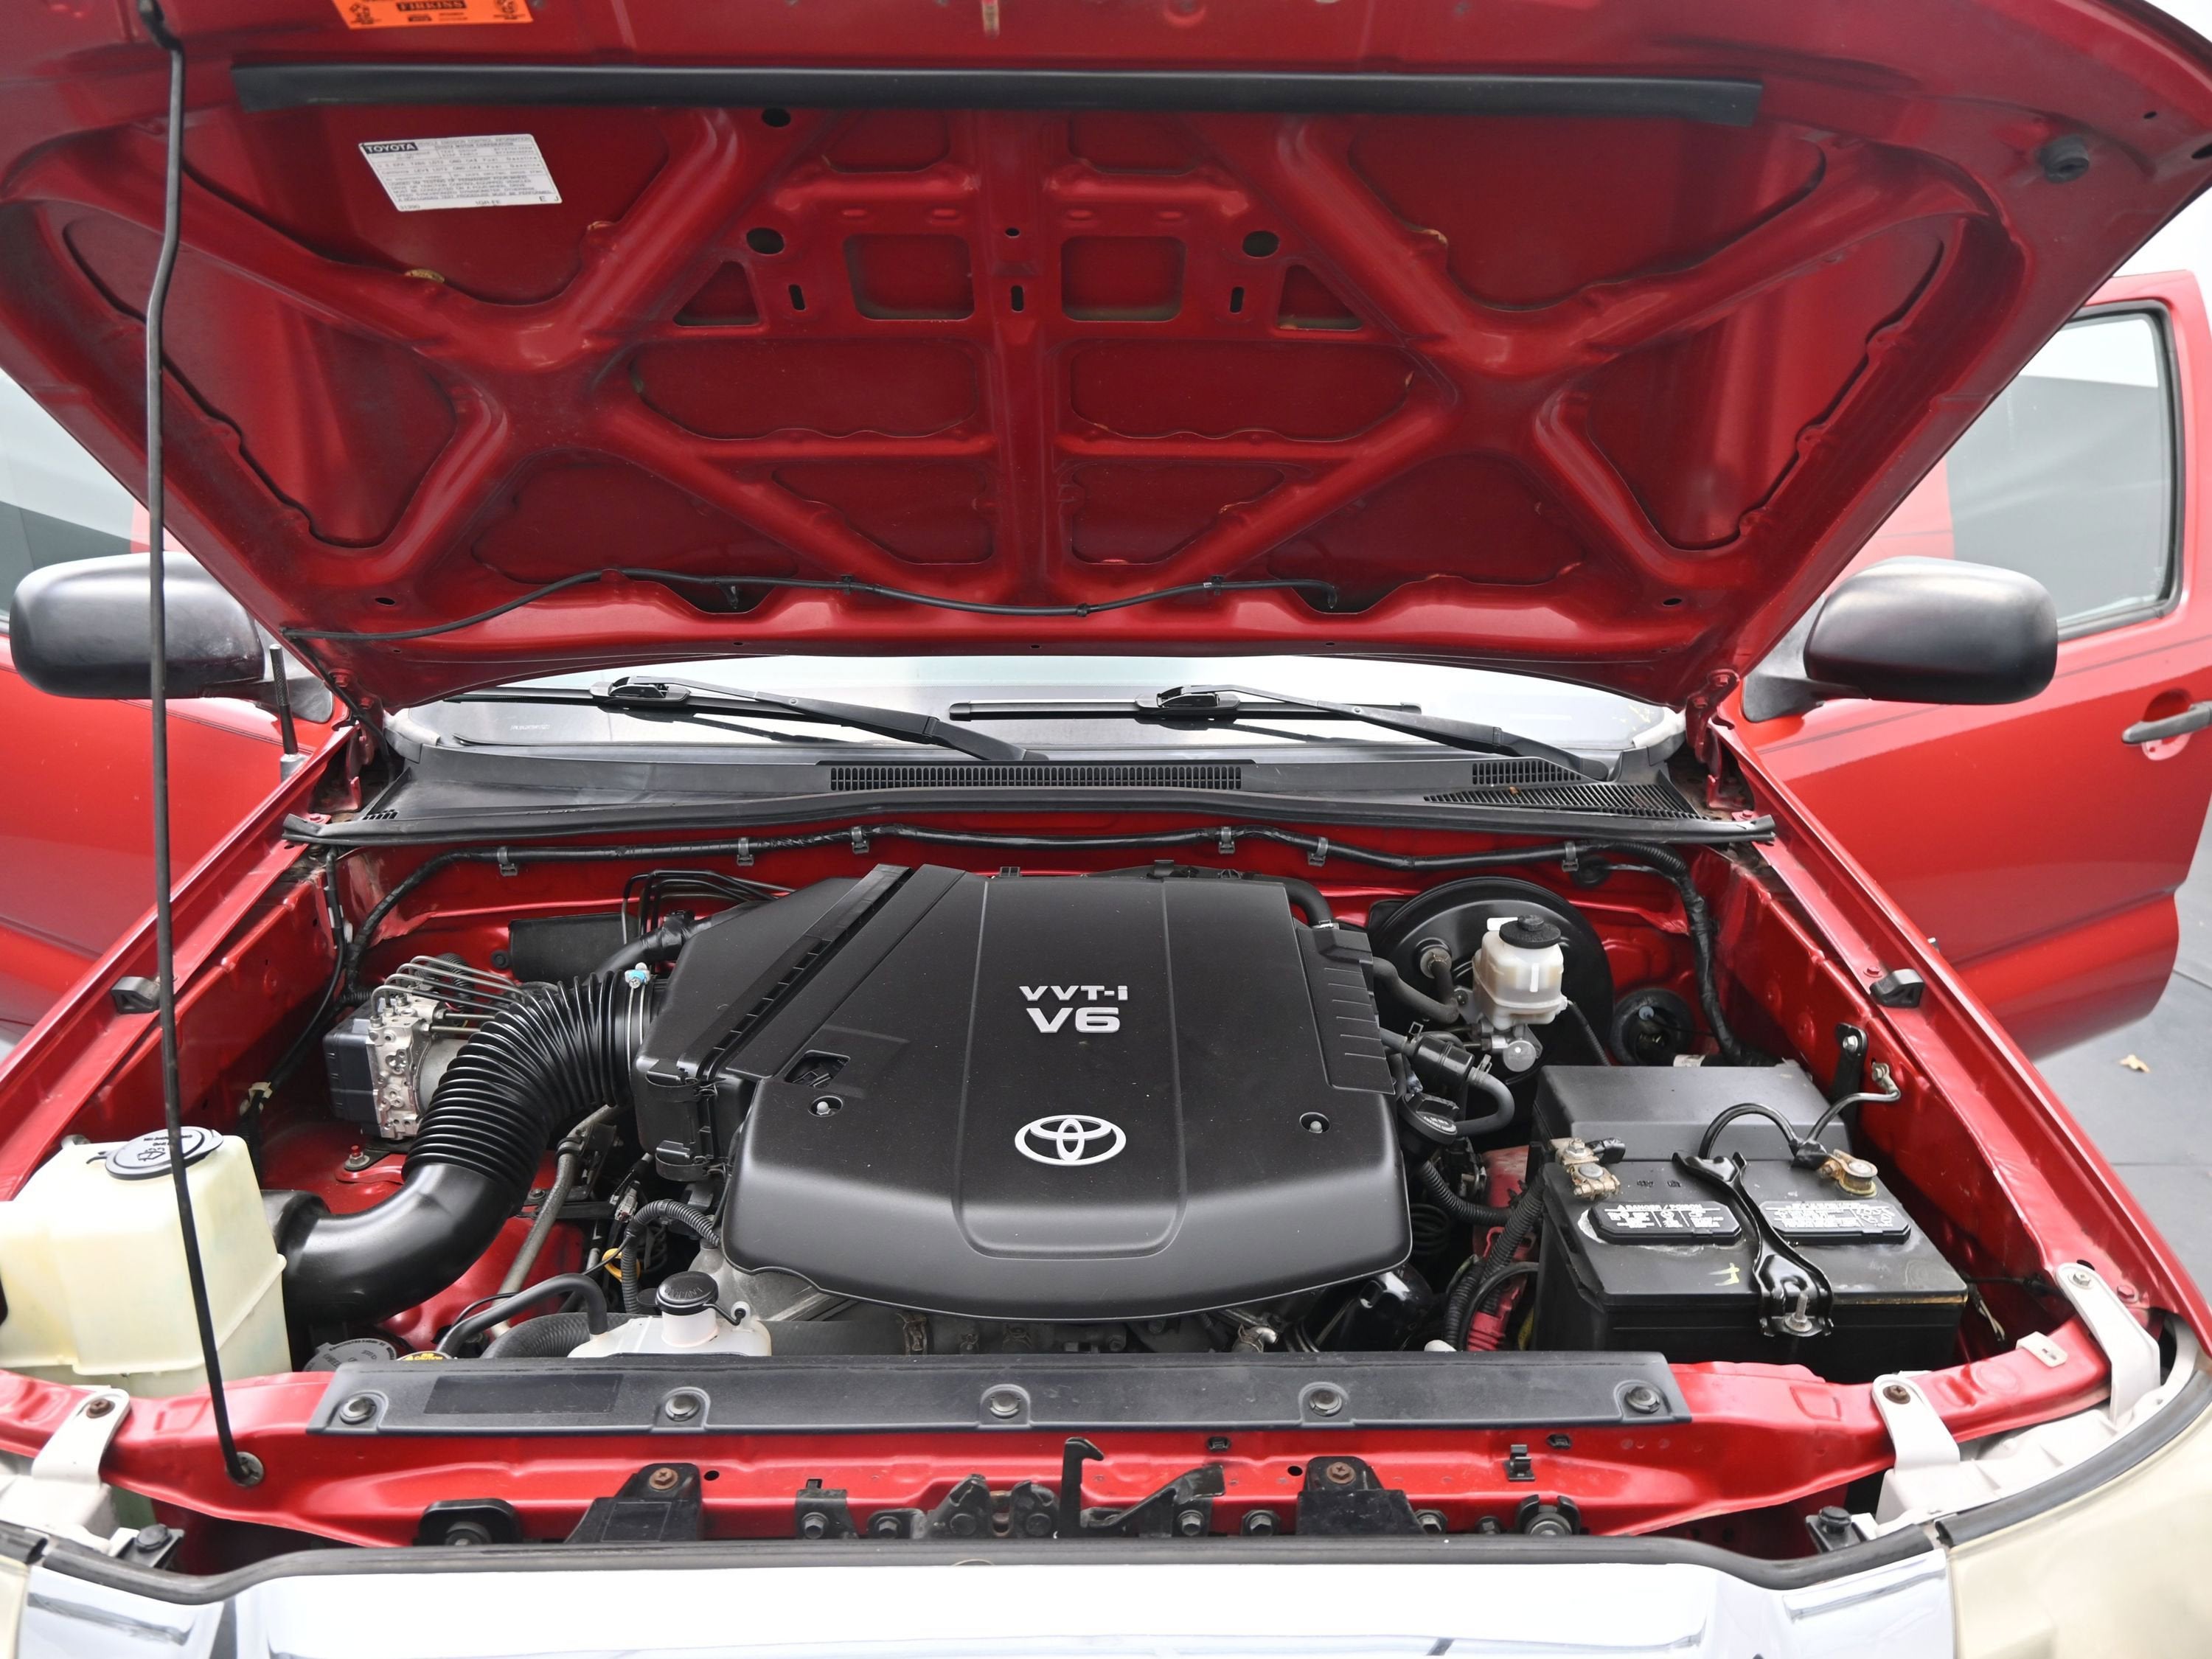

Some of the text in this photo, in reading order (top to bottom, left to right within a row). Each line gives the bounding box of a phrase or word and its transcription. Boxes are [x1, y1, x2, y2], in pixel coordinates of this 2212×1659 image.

[366, 143, 417, 153] TOYOTA
[1019, 985, 1128, 1001] VVT-i
[1026, 1007, 1120, 1032] V6
